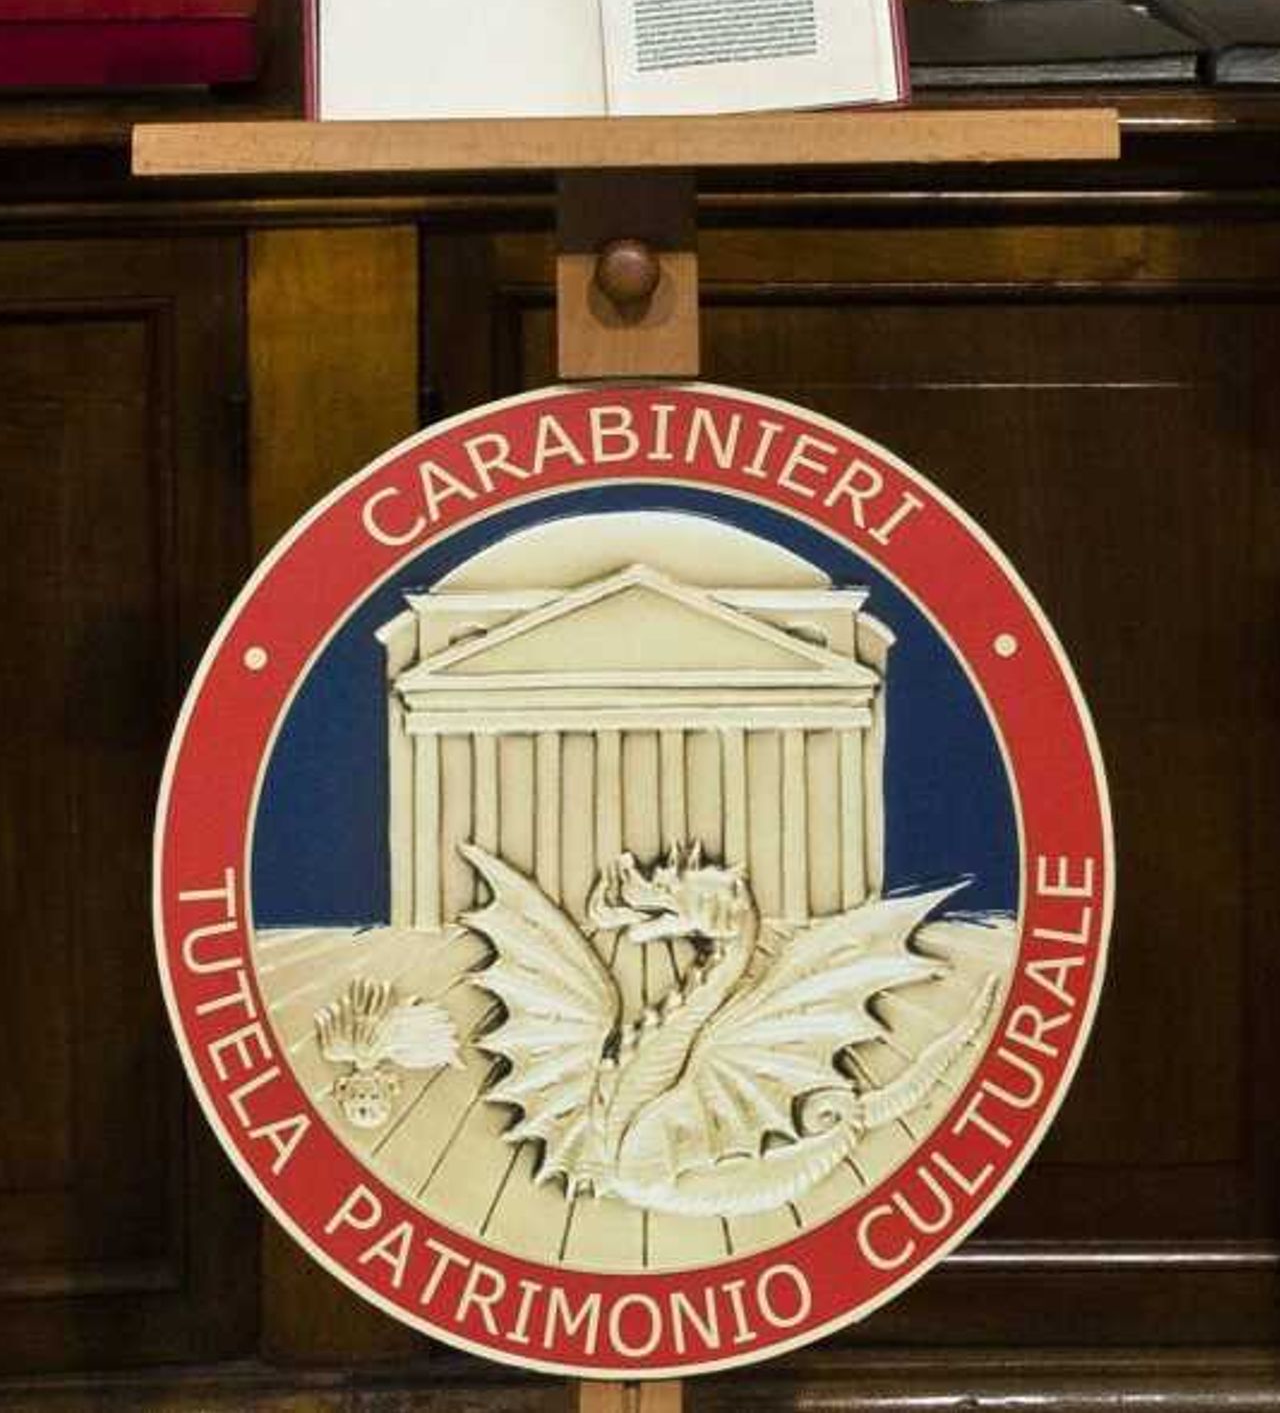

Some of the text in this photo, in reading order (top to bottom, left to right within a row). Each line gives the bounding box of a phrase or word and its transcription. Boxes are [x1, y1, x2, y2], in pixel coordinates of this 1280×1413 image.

[361, 404, 924, 546] CARABINIERI
[178, 855, 1094, 1358] TUTELA PATRIMONIO CULTURALE
